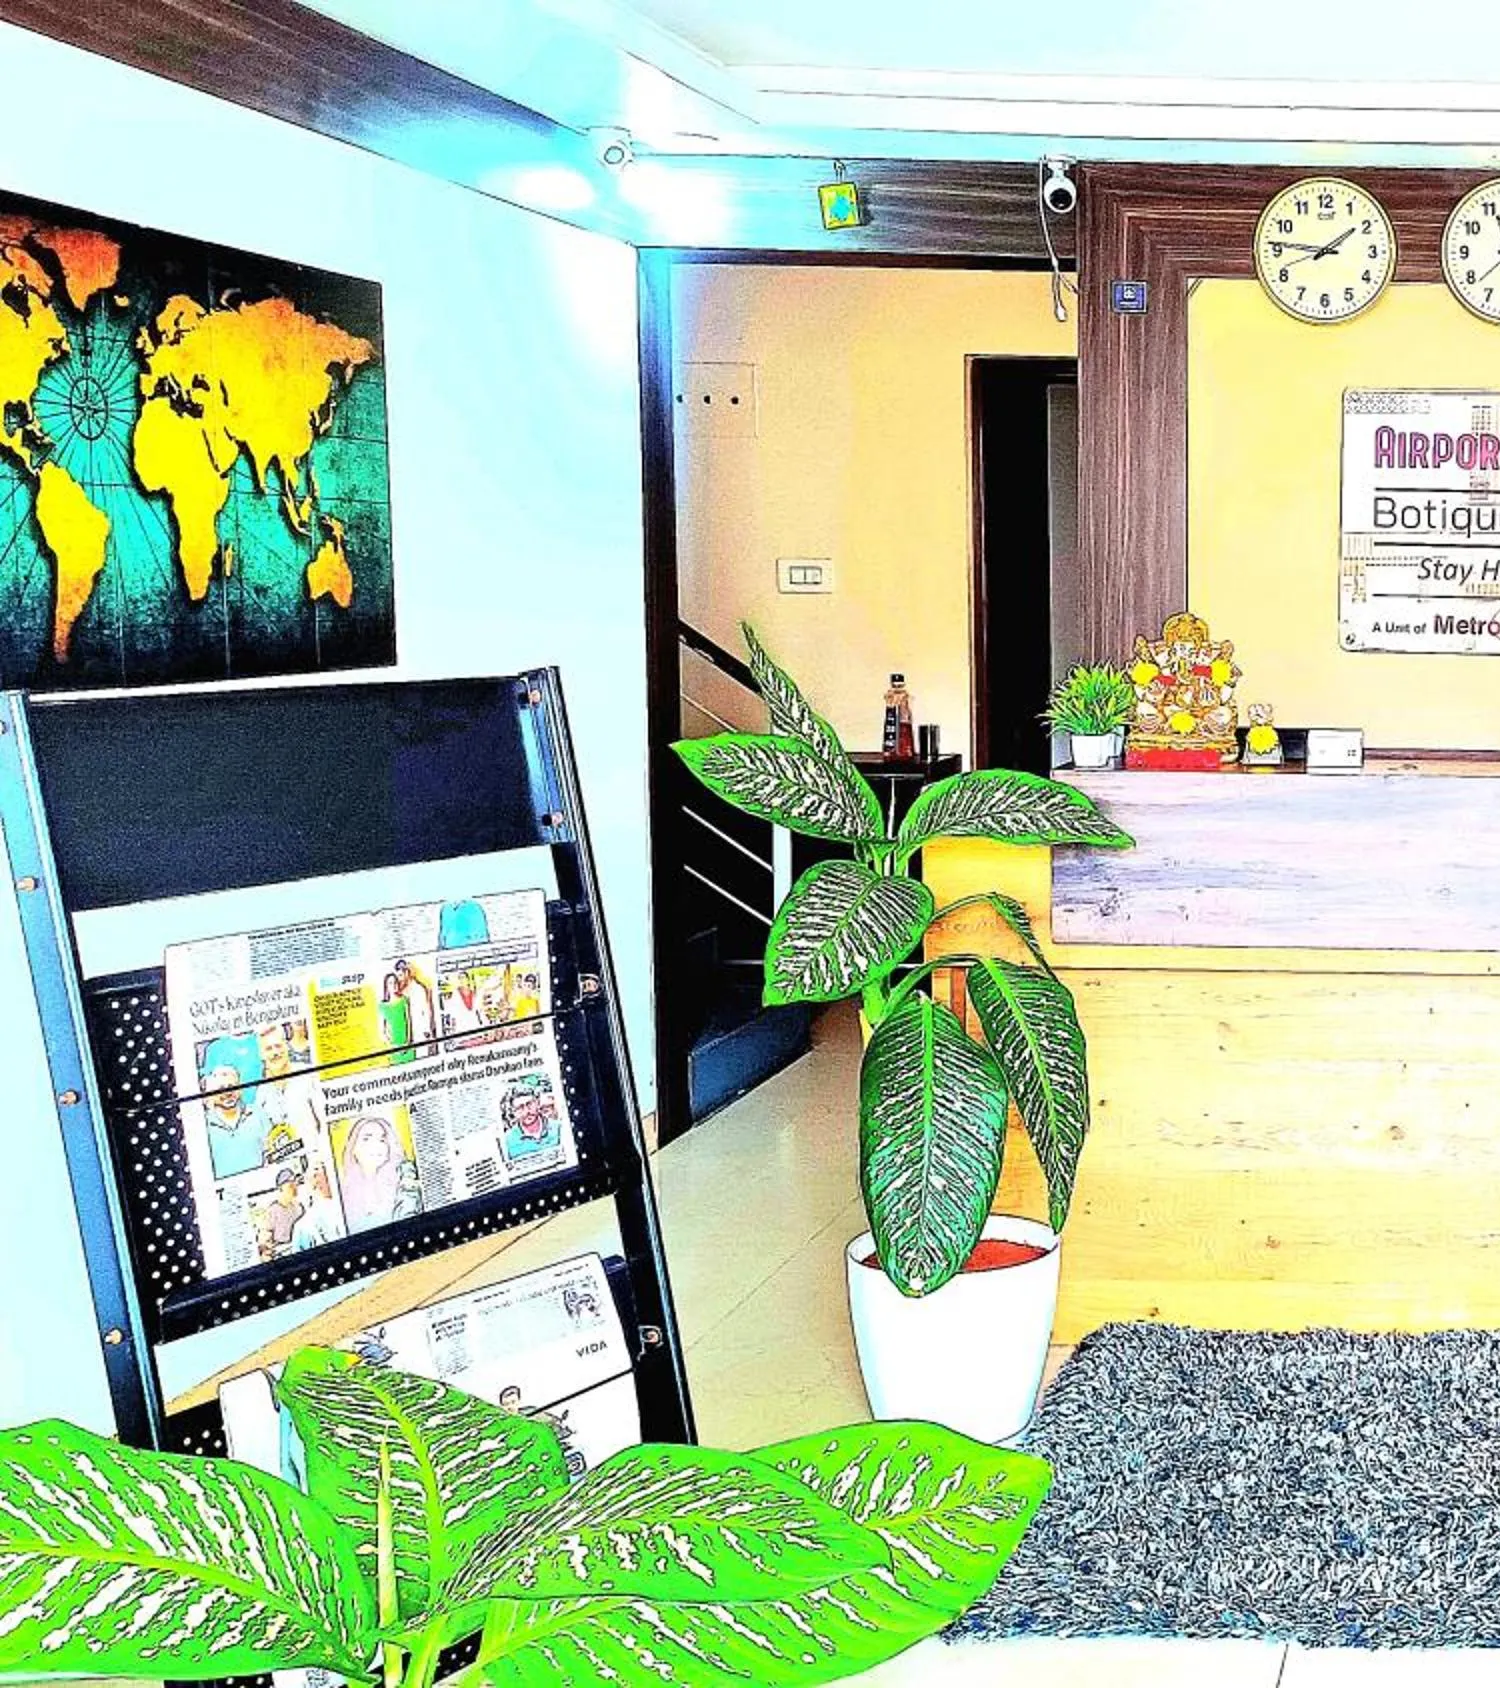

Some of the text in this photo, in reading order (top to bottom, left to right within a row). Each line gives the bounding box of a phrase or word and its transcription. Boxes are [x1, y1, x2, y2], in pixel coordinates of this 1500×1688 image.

[1294, 200, 1308, 215] 11
[1318, 193, 1334, 209] 12
[1345, 201, 1353, 216] 1
[1481, 201, 1496, 216] 11
[1276, 219, 1293, 233] 10
[1361, 219, 1372, 235] 2
[1463, 220, 1481, 236] 10
[1367, 244, 1378, 259] 3
[1459, 245, 1470, 260] 9
[1279, 268, 1289, 283] 8
[1361, 269, 1371, 284] 4
[1465, 269, 1477, 285] 8
[1296, 286, 1307, 301] 7
[1319, 293, 1330, 308] 6
[1343, 287, 1354, 302] 5
[1483, 287, 1494, 303] 7
[1417, 557, 1474, 586] Stay
[1372, 621, 1382, 633] A
[1385, 621, 1411, 634] Unit
[1413, 622, 1427, 635] of
[1433, 614, 1500, 637] Metro
[321, 1085, 350, 1100] Your
[324, 1097, 363, 1116] family
[576, 1339, 608, 1358] VIDA
